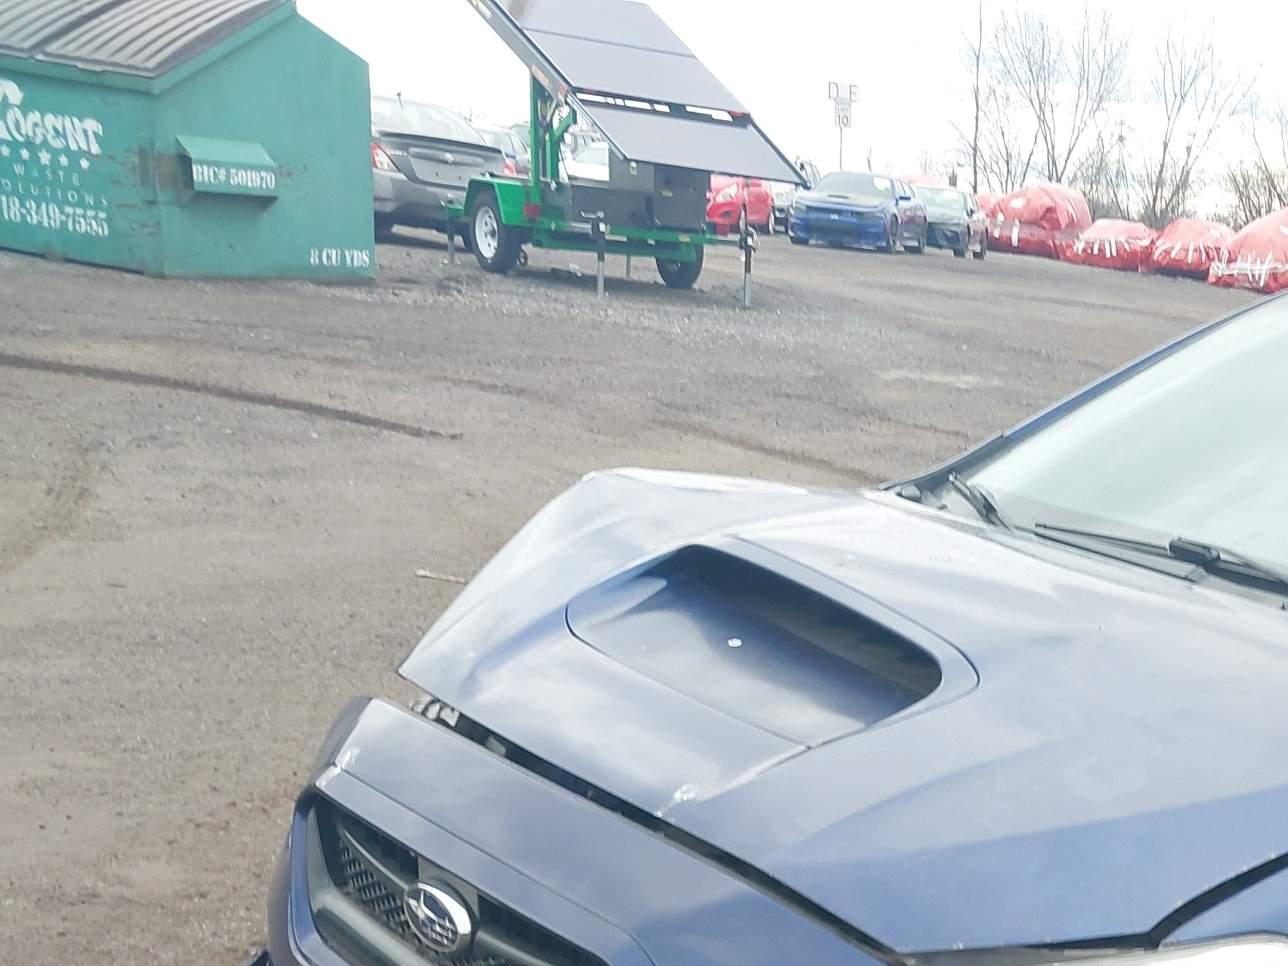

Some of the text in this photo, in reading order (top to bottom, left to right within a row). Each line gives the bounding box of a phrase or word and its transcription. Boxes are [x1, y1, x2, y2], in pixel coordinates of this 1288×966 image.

[309, 248, 371, 268] 8 CU YDS
